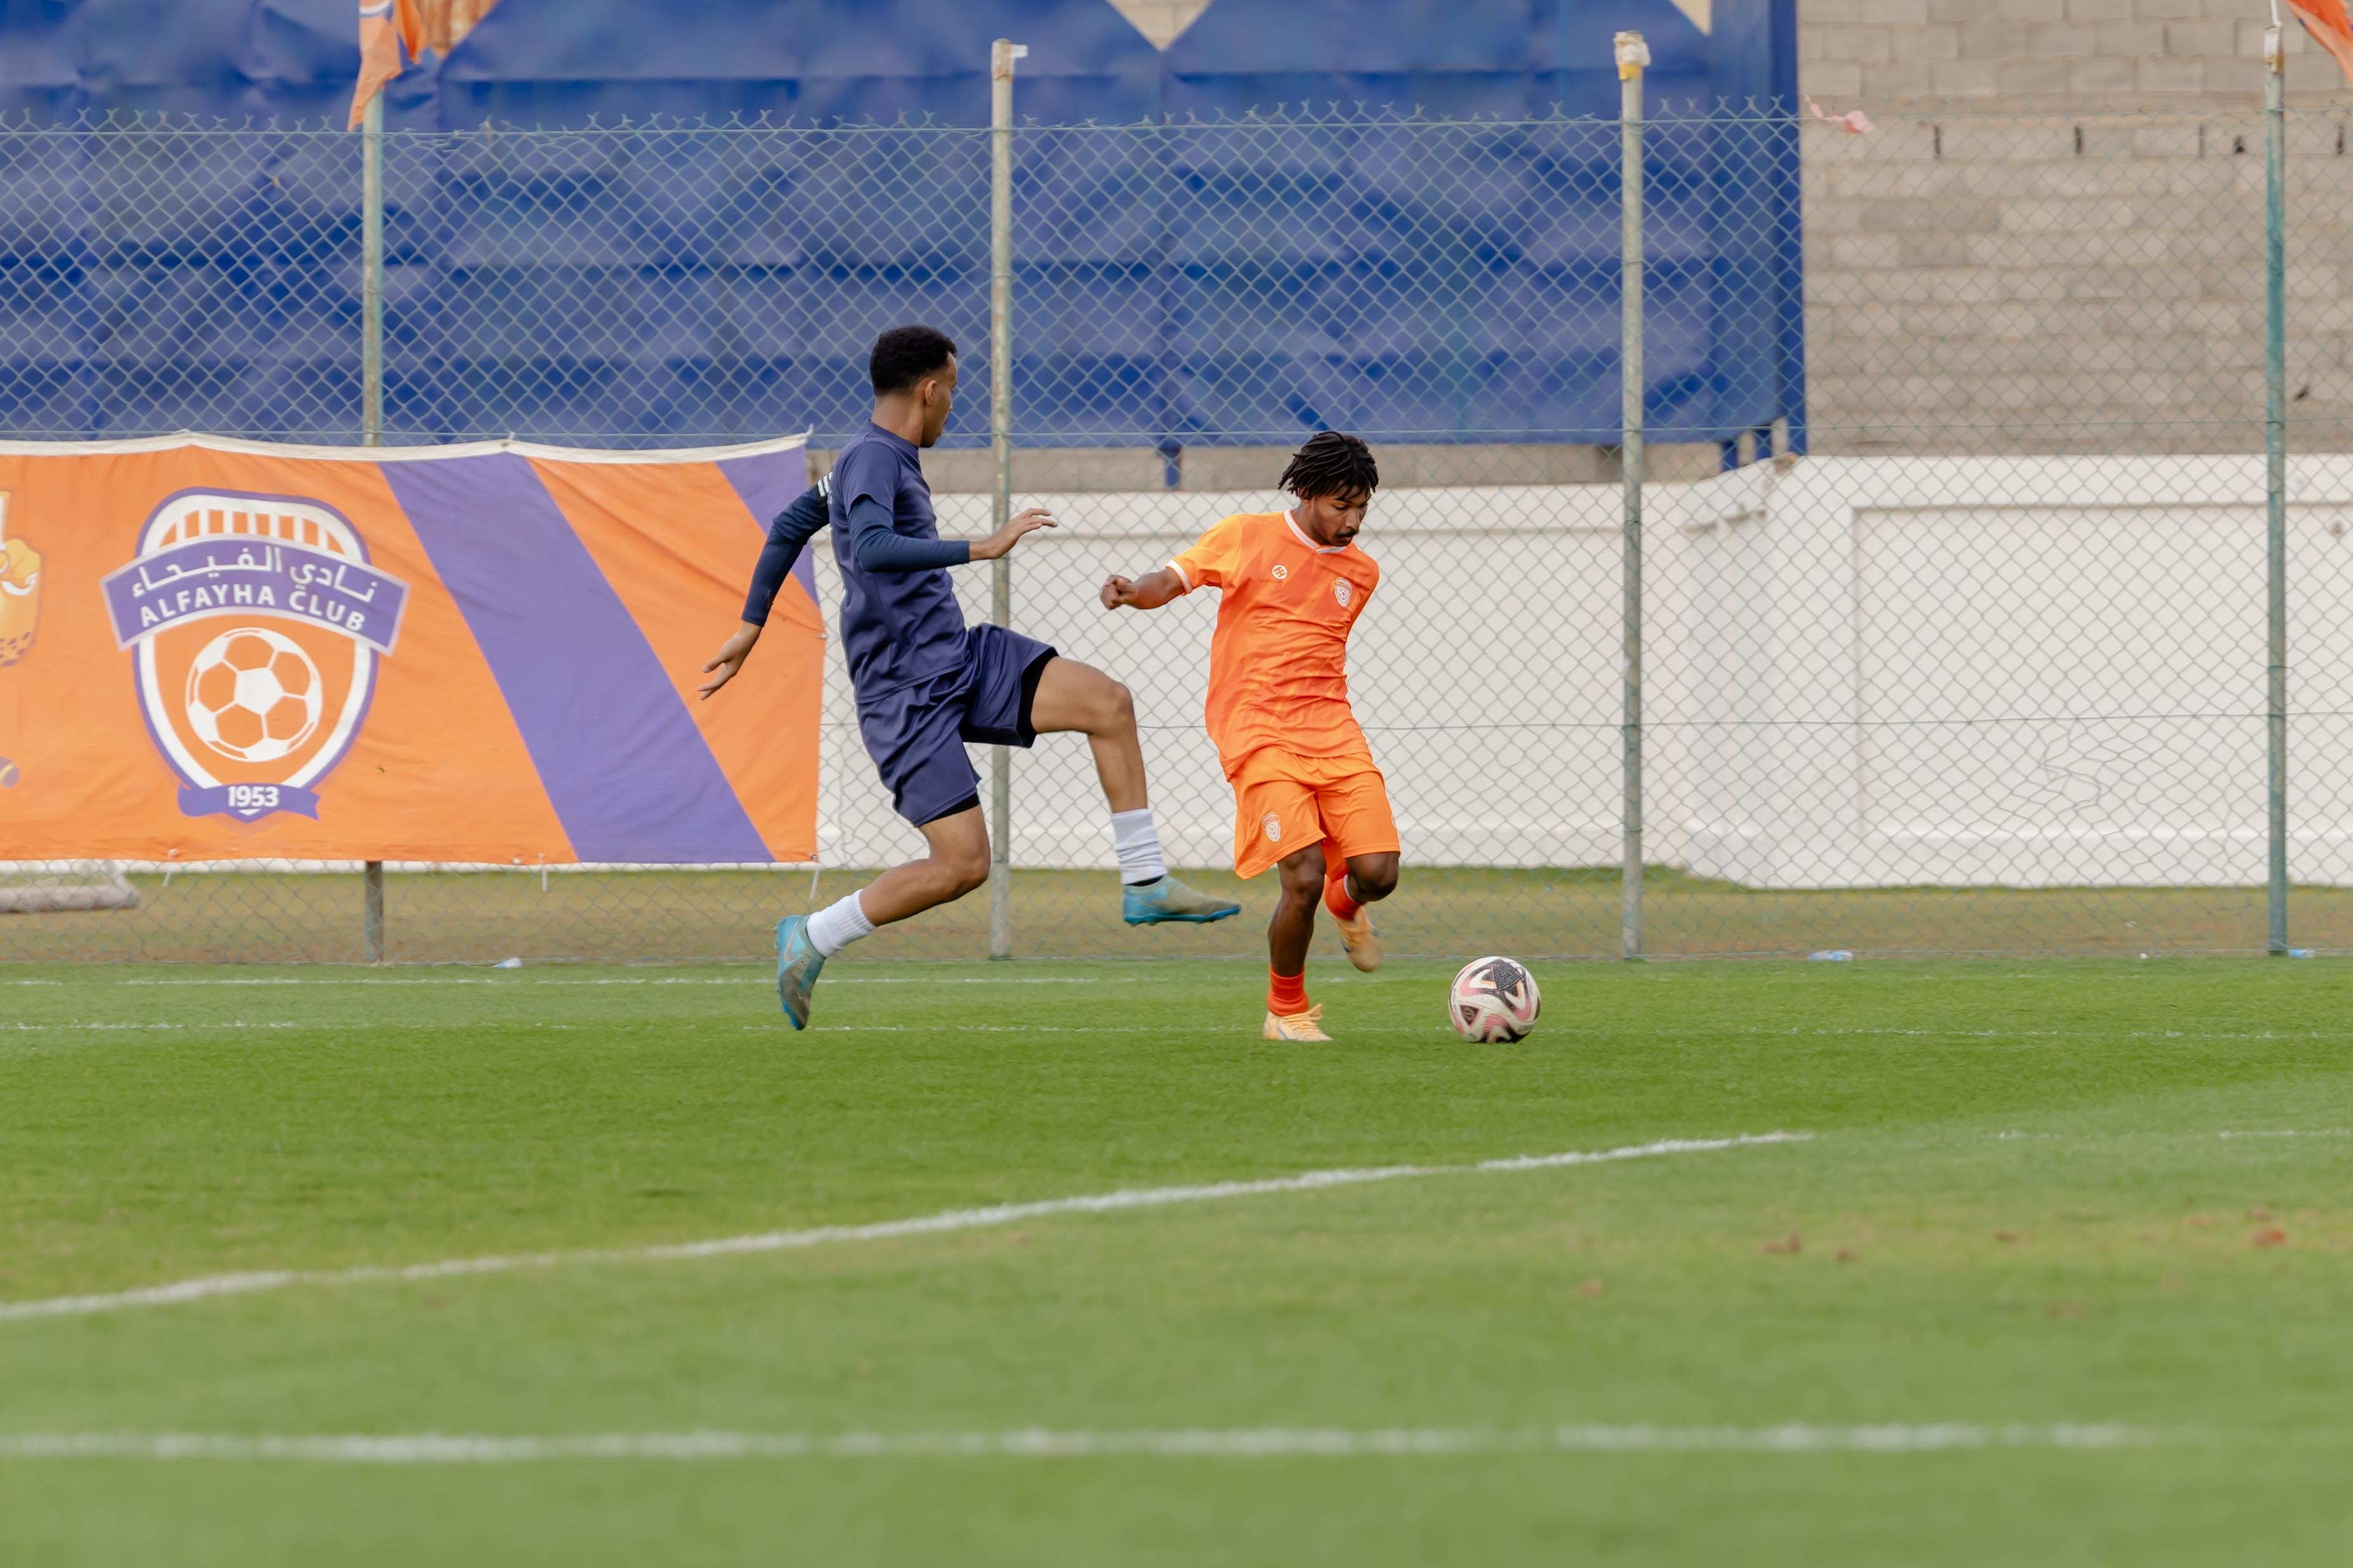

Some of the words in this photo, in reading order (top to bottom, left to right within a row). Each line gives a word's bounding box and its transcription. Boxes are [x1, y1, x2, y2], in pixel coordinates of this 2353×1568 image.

[132, 545, 283, 598] الفيحاء
[289, 564, 378, 604] نادي
[139, 583, 276, 628] ALFAYHA
[289, 589, 366, 632] CLUB
[228, 786, 279, 806] 1953
